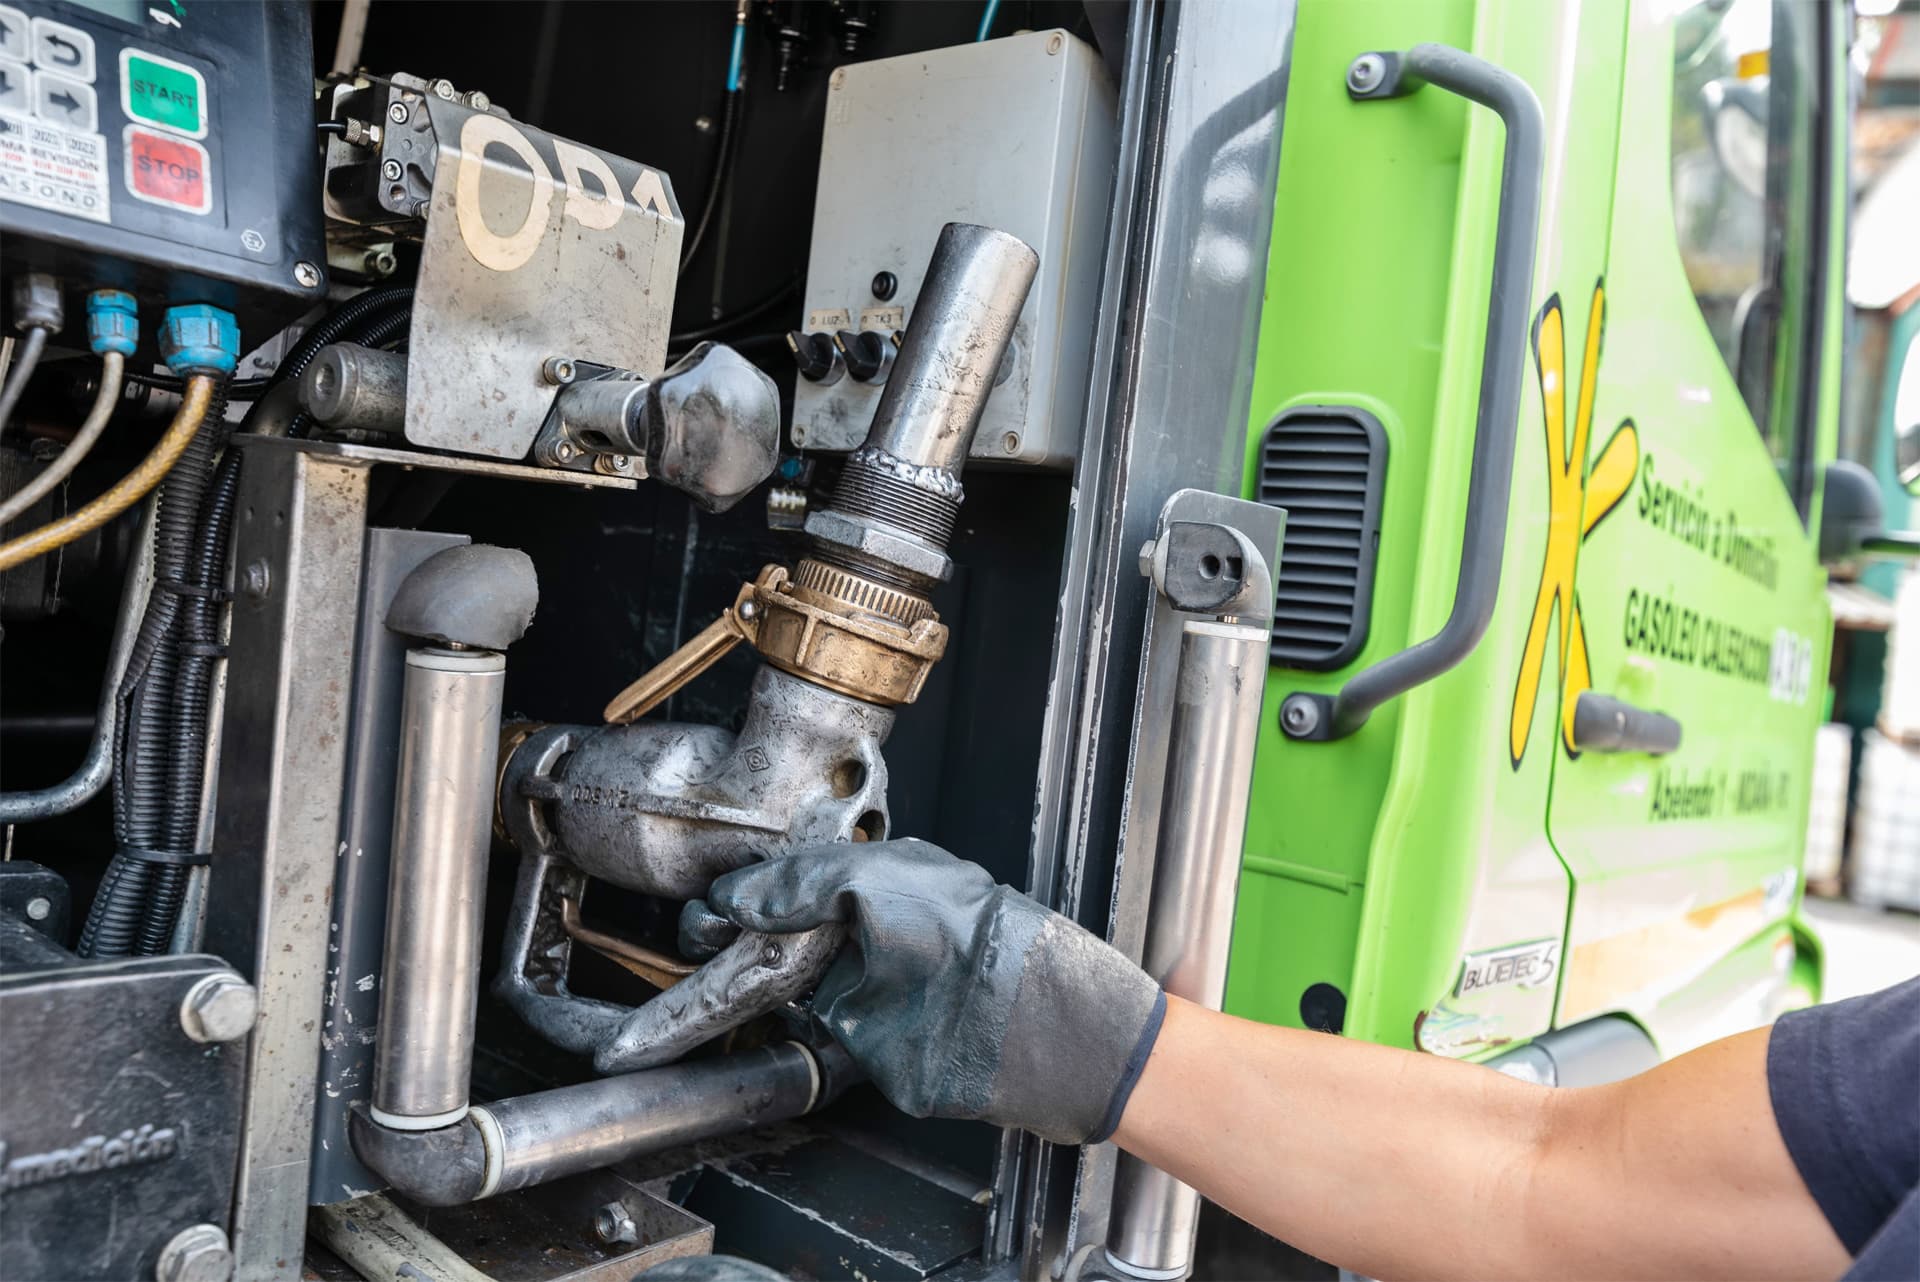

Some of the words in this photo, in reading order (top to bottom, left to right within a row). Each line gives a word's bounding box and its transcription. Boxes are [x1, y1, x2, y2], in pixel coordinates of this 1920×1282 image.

[133, 79, 196, 110] START
[137, 155, 200, 183] STOP
[39, 185, 54, 199] O
[1638, 453, 1709, 553] Servicio
[1462, 949, 1541, 992] BLUETEC
